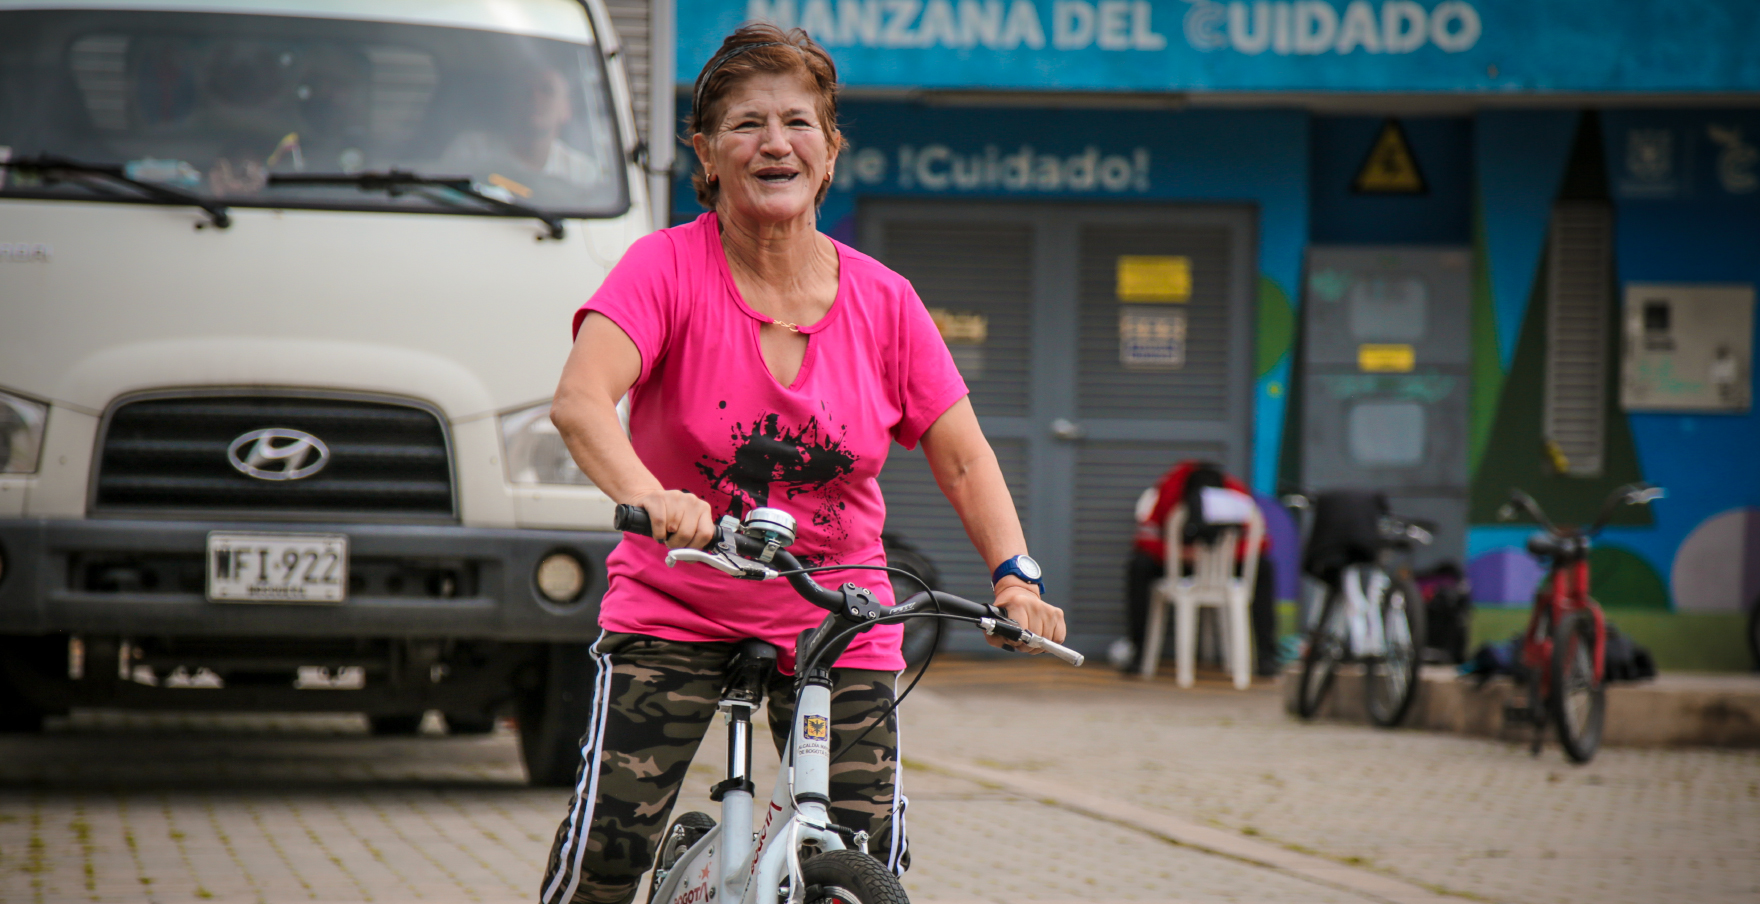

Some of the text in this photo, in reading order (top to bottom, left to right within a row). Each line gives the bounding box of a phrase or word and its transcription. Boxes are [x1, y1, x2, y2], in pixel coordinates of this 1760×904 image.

[746, 0, 1483, 55] MANZANA DEL CUIDADO
